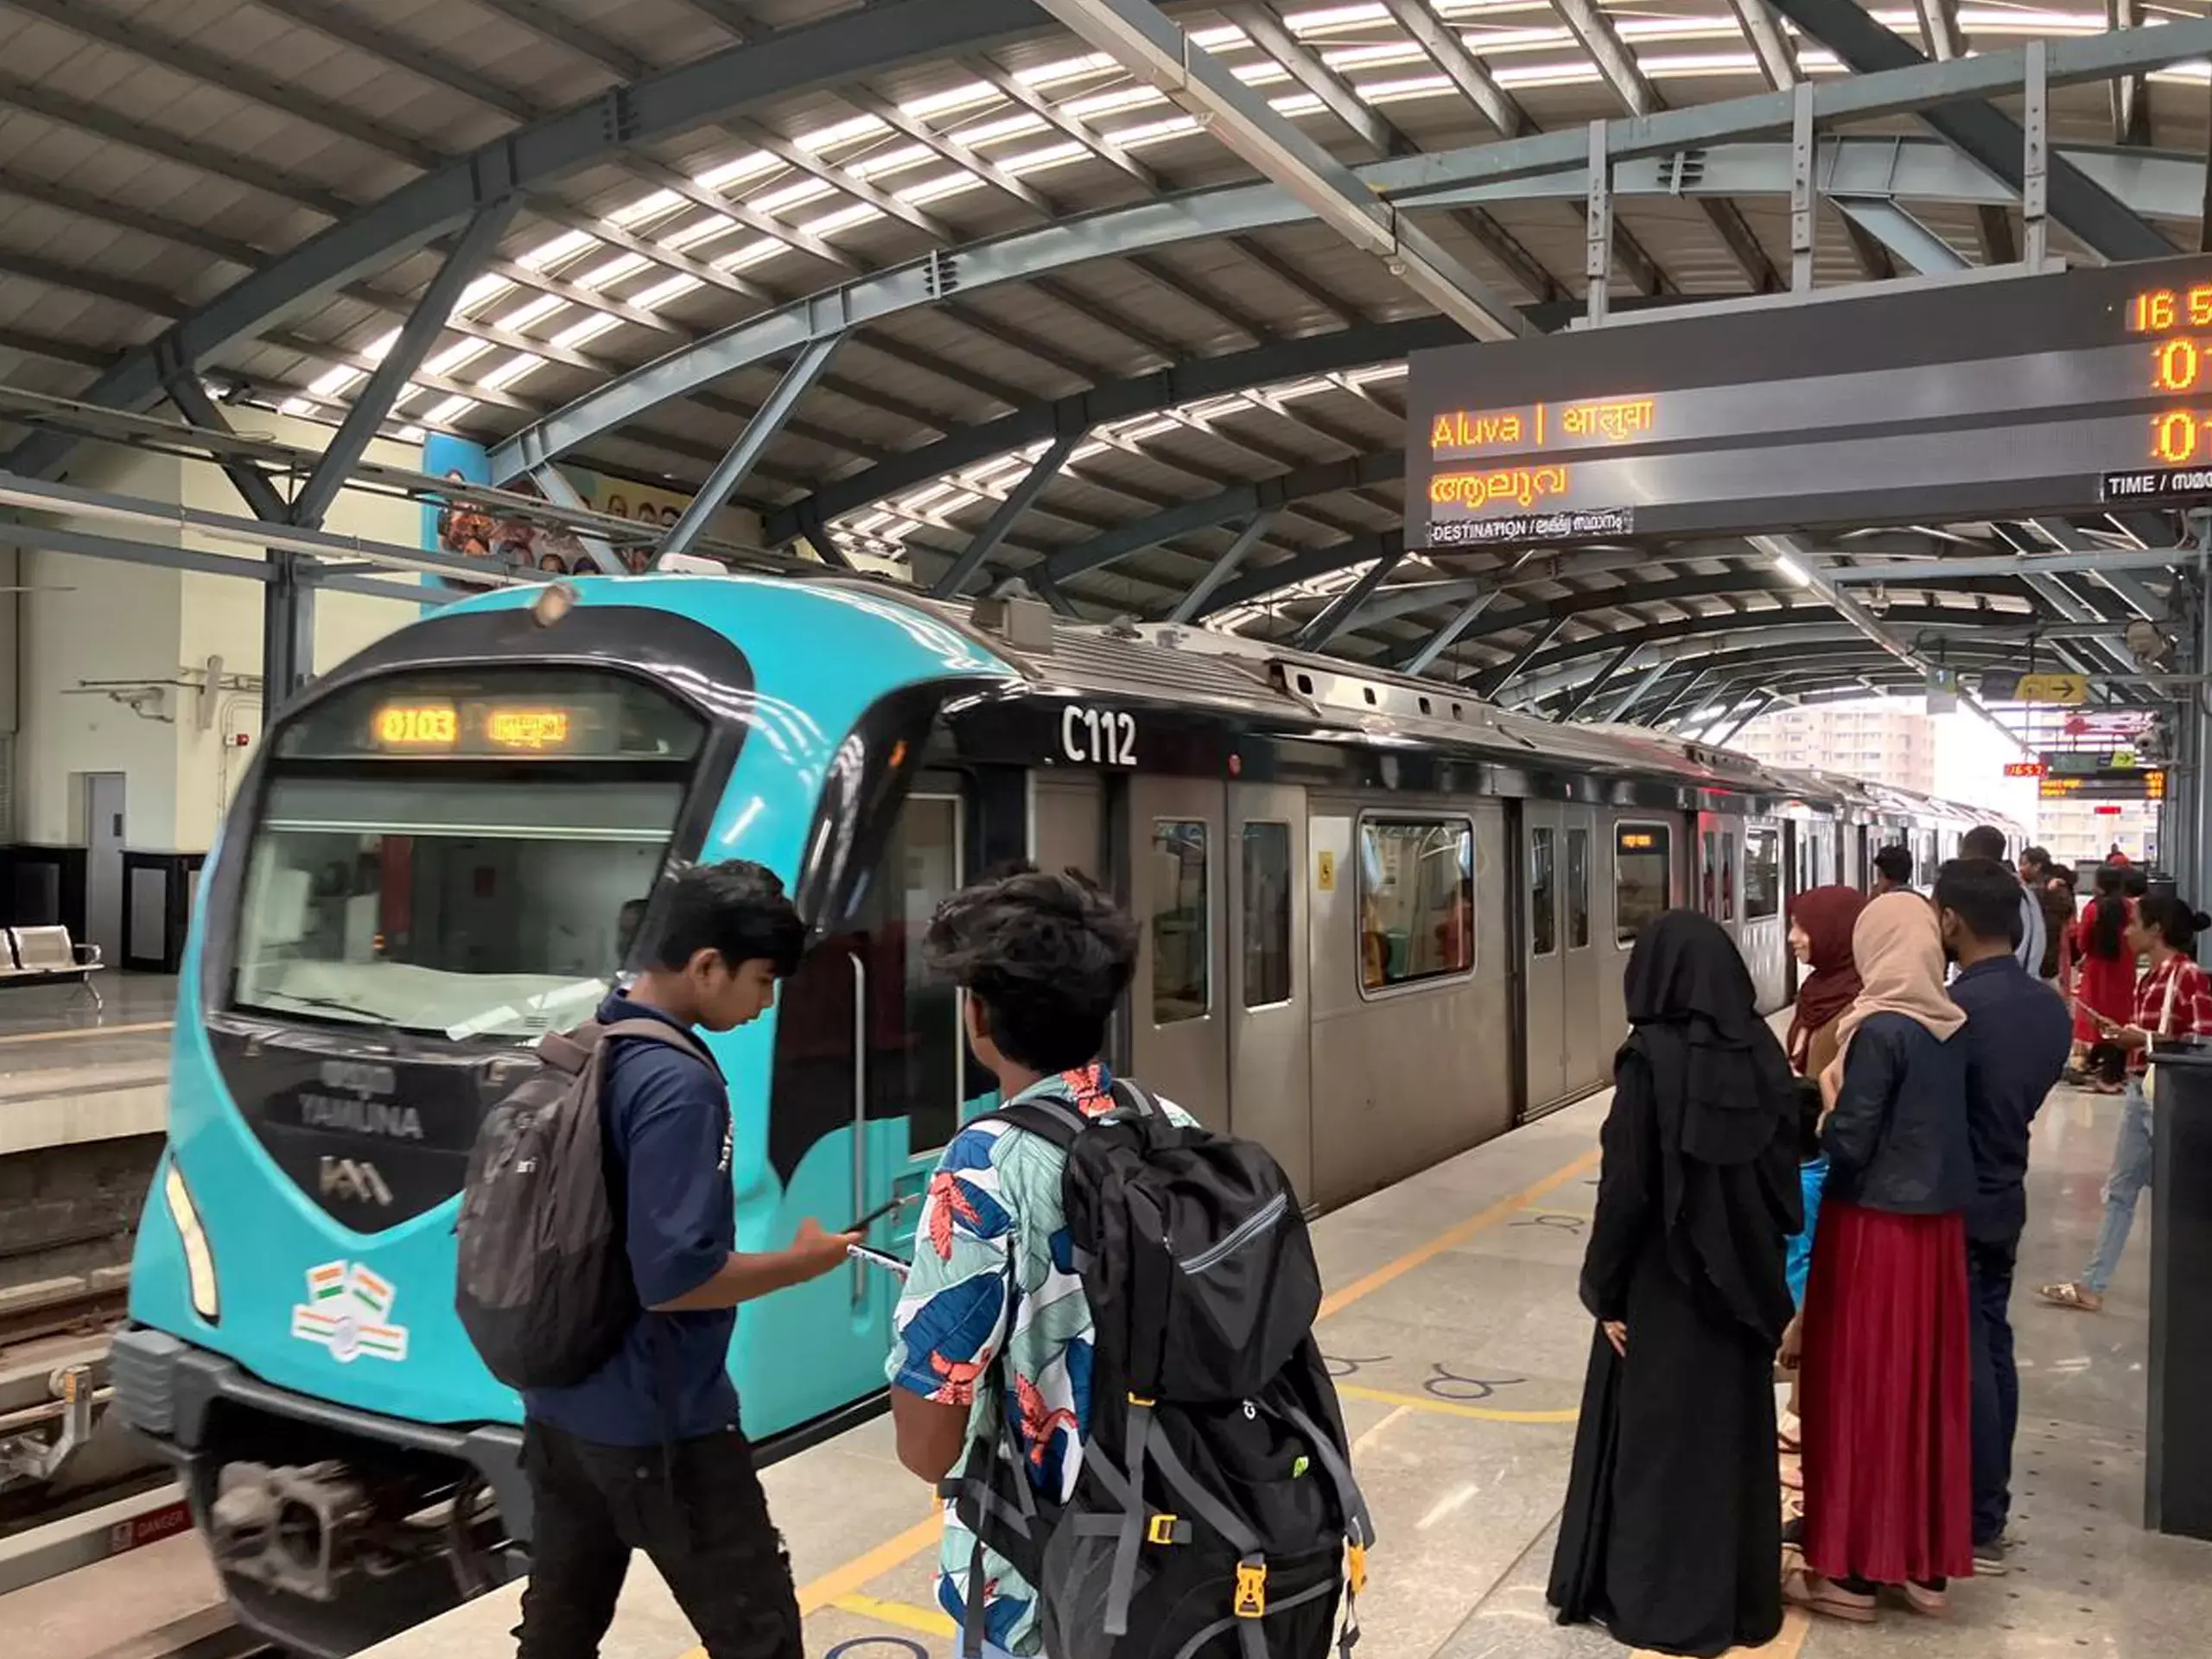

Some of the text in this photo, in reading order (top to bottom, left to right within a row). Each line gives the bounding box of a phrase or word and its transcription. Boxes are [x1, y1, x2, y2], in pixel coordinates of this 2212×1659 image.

[2137, 289, 2174, 332] 16
[1431, 411, 1519, 448] Aluva
[1430, 467, 1567, 508] ആലുവ
[2108, 474, 2155, 495] TIME
[1432, 519, 1527, 542] DESTINATION
[380, 709, 457, 742] 0103
[1062, 704, 1138, 766] C112
